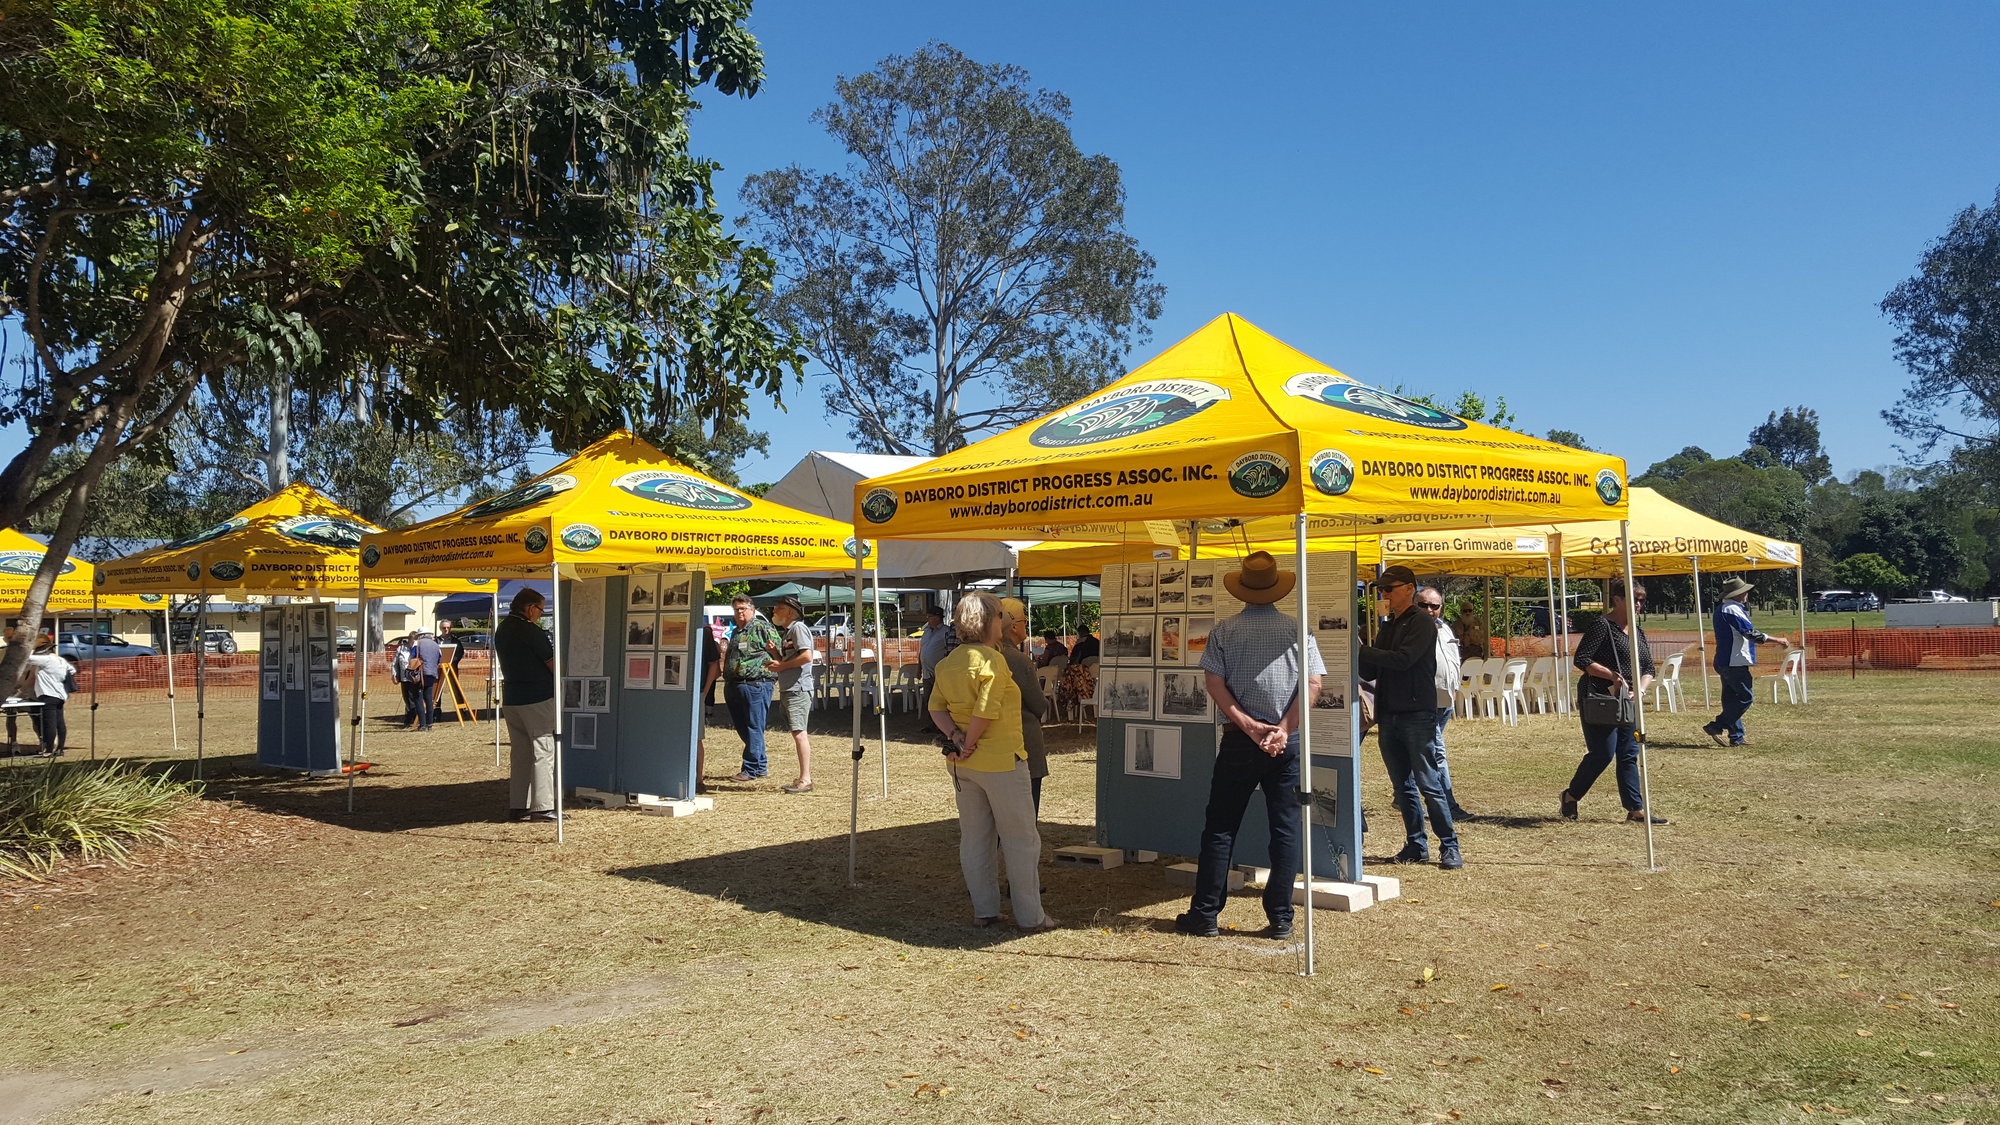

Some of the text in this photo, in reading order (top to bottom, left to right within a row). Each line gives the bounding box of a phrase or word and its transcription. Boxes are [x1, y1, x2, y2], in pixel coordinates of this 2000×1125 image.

[1080, 382, 1210, 411] DAYBORO DISTRICT
[1069, 428, 1139, 446] ASSOCIATION
[1143, 420, 1165, 431] INC
[1236, 453, 1281, 468] DAYBORO DISTRICT
[625, 472, 669, 484] DAYBORO
[1361, 460, 1424, 477] DAYBORO
[1427, 462, 1477, 479] DISTRICT
[1480, 467, 1534, 483] PROGRESS
[1536, 470, 1572, 486] ASSOC.
[1573, 473, 1591, 488] INC.
[905, 464, 1218, 504] DAYBORO DISTRICT PROGRESS ASSOC. INC.
[654, 497, 696, 508] PROGRESS
[1409, 485, 1561, 505] www.dayborodistrict.com.au
[950, 493, 1153, 519] www.dayborodistrict.com.au
[620, 510, 674, 519] Dayboro
[677, 512, 718, 521] District
[722, 515, 770, 524] Progress
[383, 543, 412, 556] DAYBORO
[413, 540, 441, 553] DISTRICT
[442, 537, 478, 549] PROGRESS
[479, 534, 505, 546] ASSOC.
[505, 532, 521, 543] INC.
[609, 530, 668, 541] DAYBORO
[671, 531, 722, 543] DISTRICT
[724, 534, 779, 545] PROGRESS
[781, 537, 818, 547] ASSOC.
[819, 538, 838, 548] INC.
[1386, 537, 1513, 552] Cr Darren Grimwade
[1590, 537, 1610, 555] Cr
[1674, 536, 1748, 554] Grimwade
[403, 550, 495, 567] www.dayborodistrict.com.au
[655, 545, 806, 557] www.dayborodistrict.com.au
[251, 563, 303, 572] DAYBORO
[305, 564, 351, 572] DISTRICT
[290, 574, 428, 584] www.dayboroistrict.com.au
[52, 588, 87, 596] OGRESS
